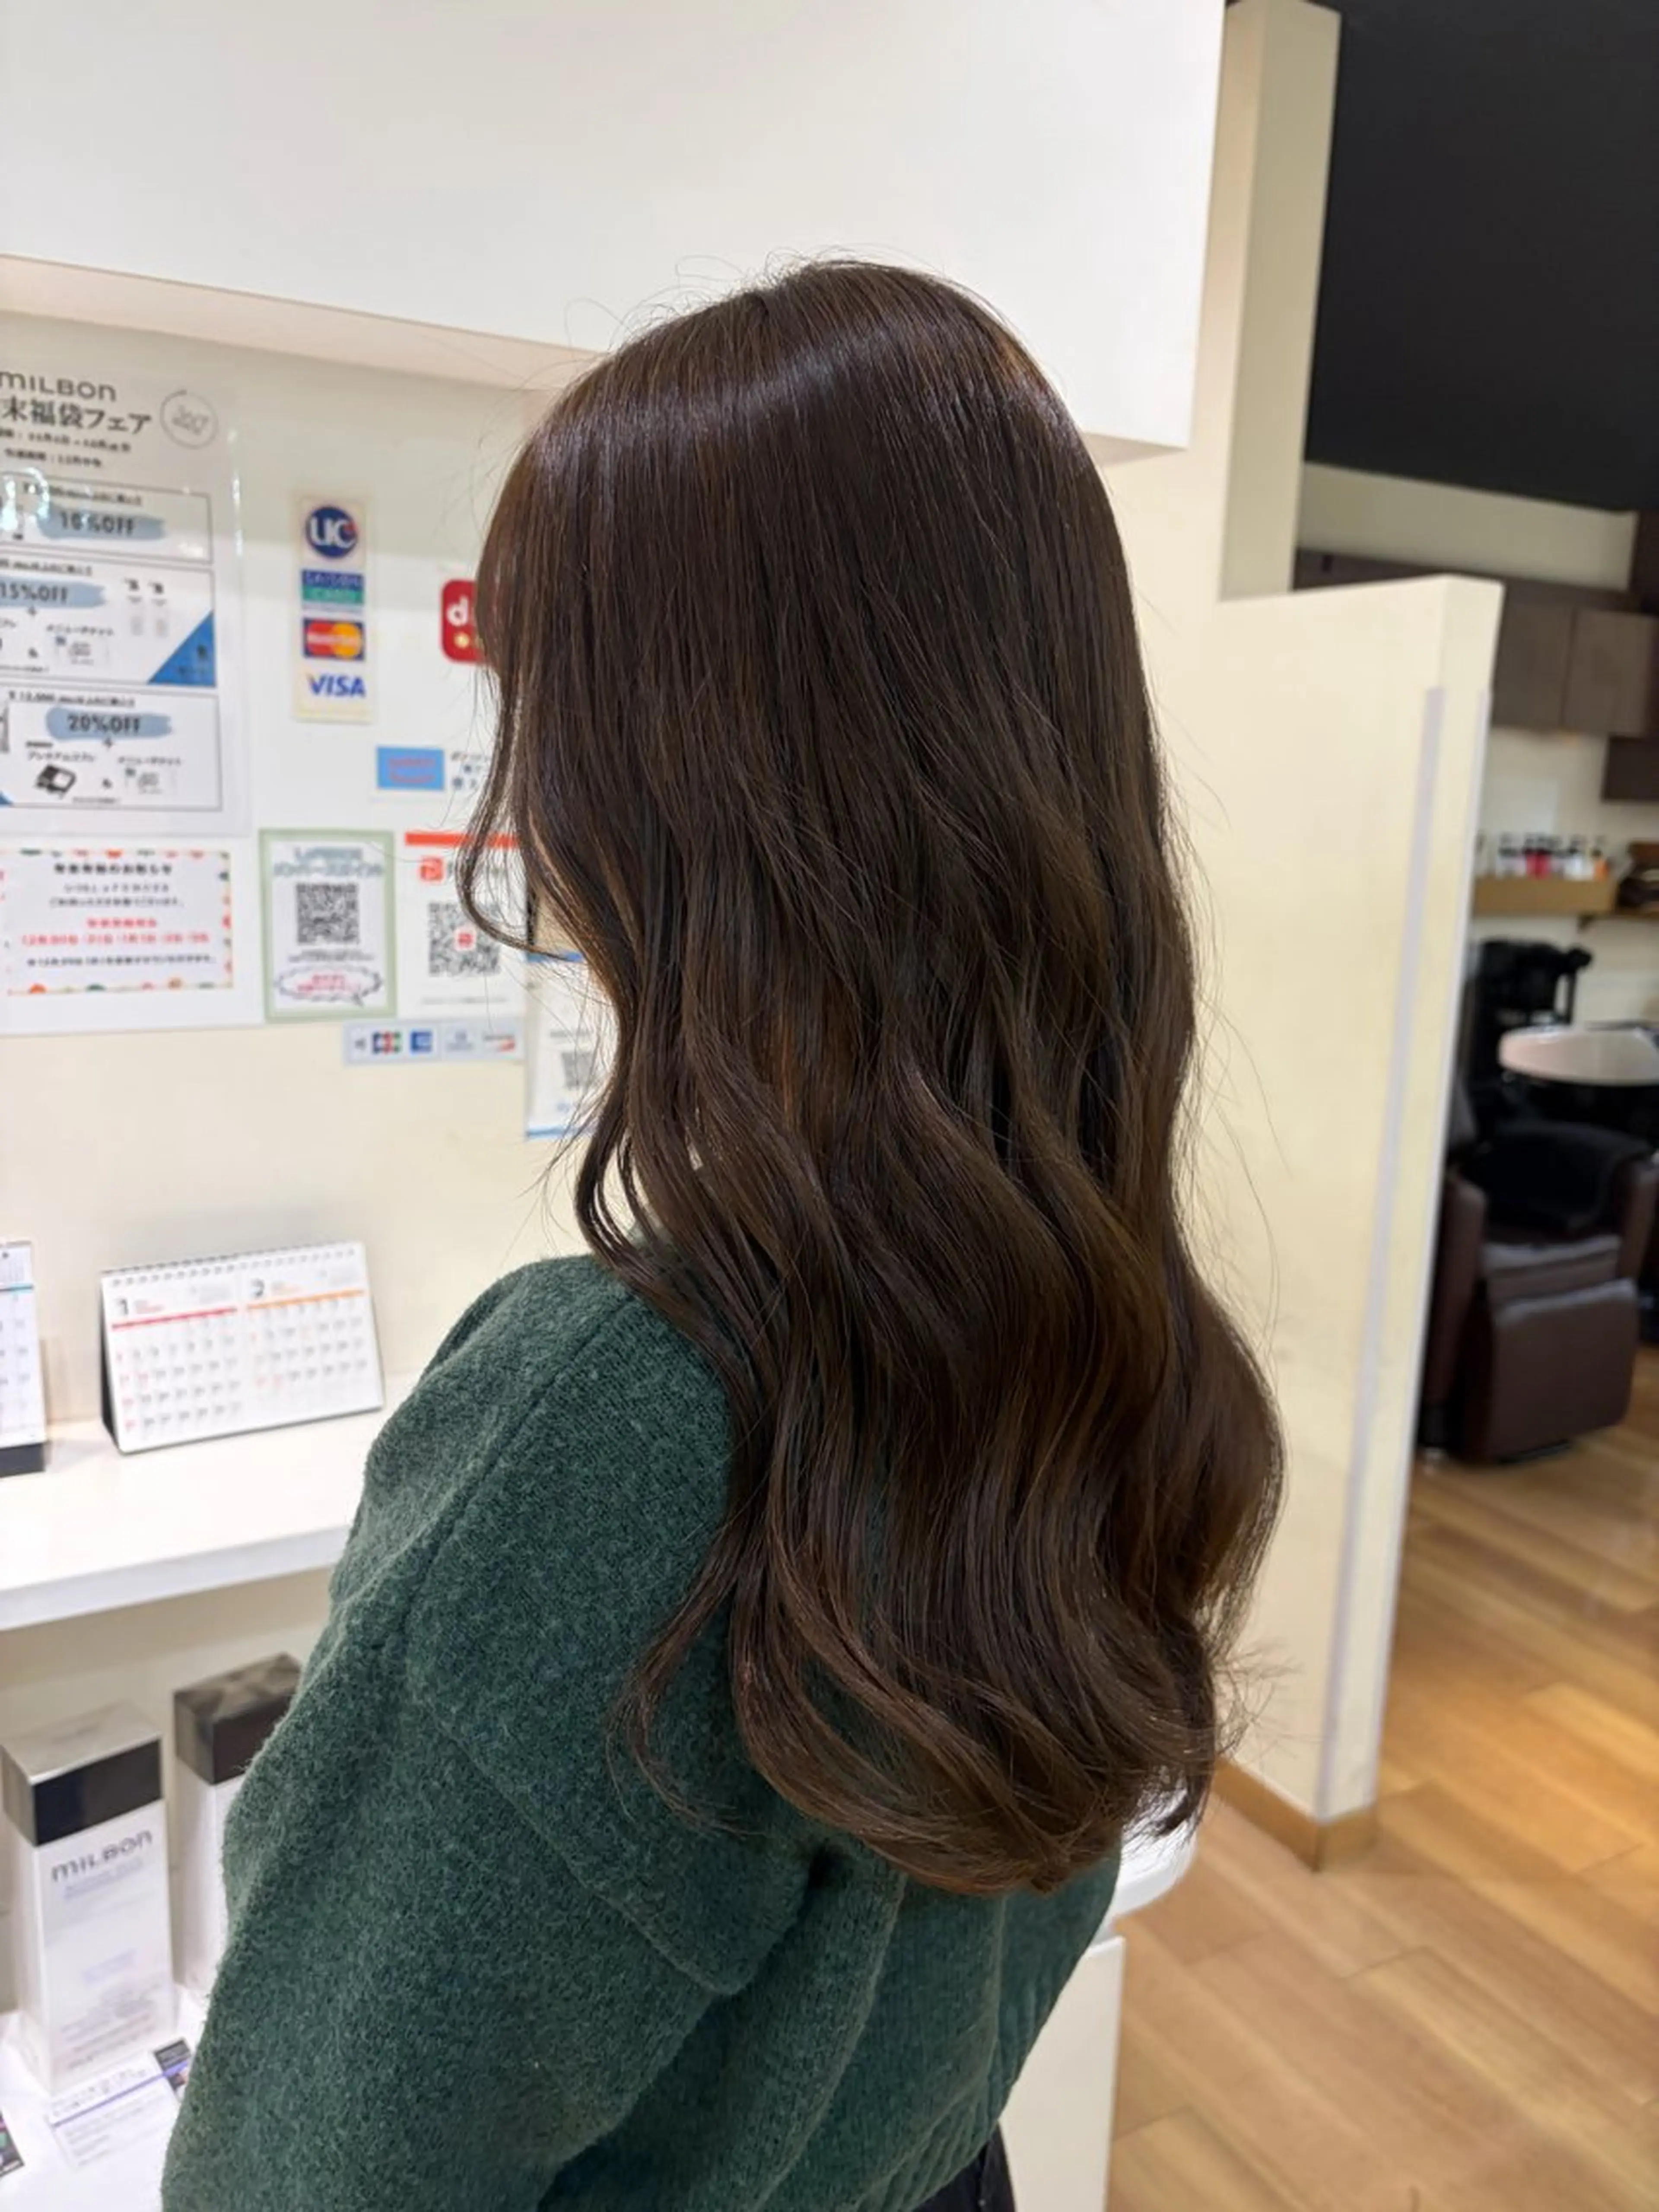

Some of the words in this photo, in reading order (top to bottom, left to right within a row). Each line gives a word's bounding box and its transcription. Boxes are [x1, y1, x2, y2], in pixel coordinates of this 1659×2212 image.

[310, 517, 356, 548] UC
[307, 673, 366, 697] VISA
[67, 714, 140, 735] 20%OFF
